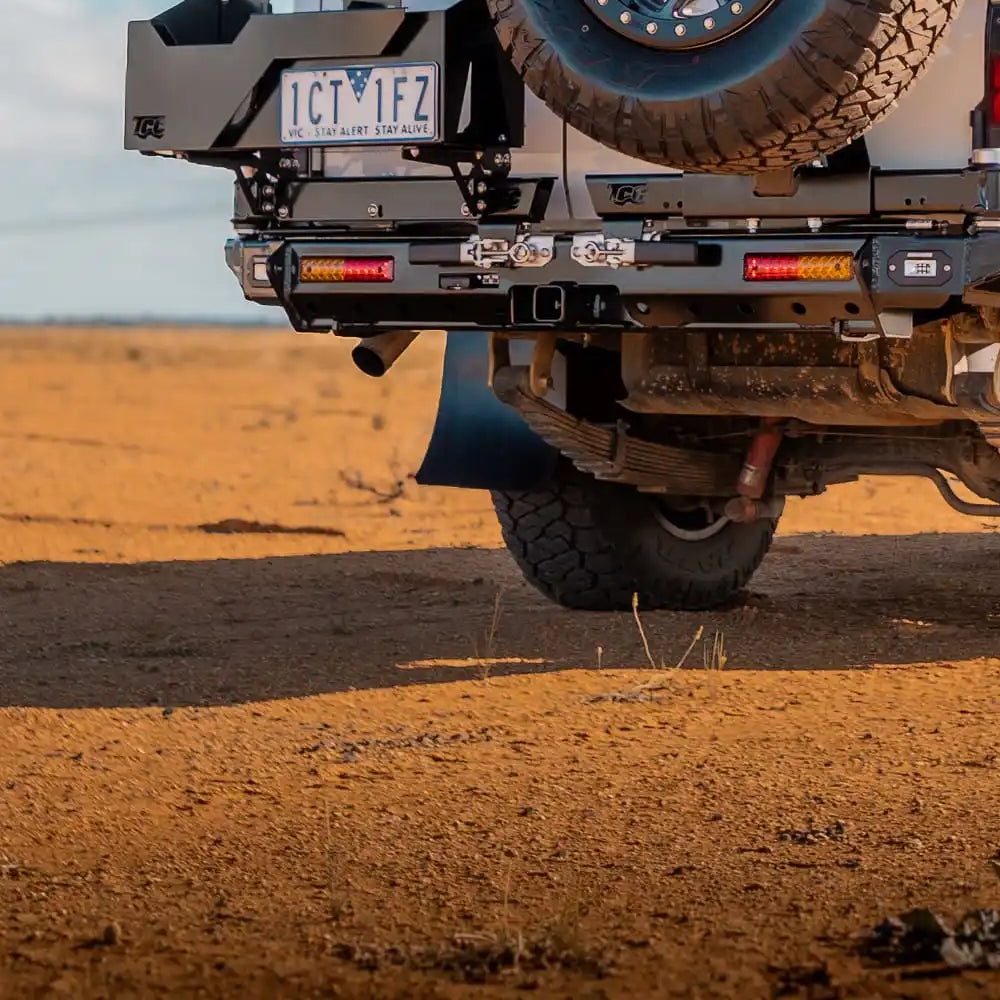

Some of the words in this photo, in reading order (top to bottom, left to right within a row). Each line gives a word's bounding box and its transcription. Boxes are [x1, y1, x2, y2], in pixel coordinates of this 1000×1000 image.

[291, 79, 343, 125] 1CT
[375, 75, 429, 123] 1FZ
[288, 128, 303, 138] VIC
[314, 127, 337, 137] STAY
[340, 126, 369, 136] ALERT
[375, 125, 398, 135] STAY
[401, 123, 428, 134] ALIVE
